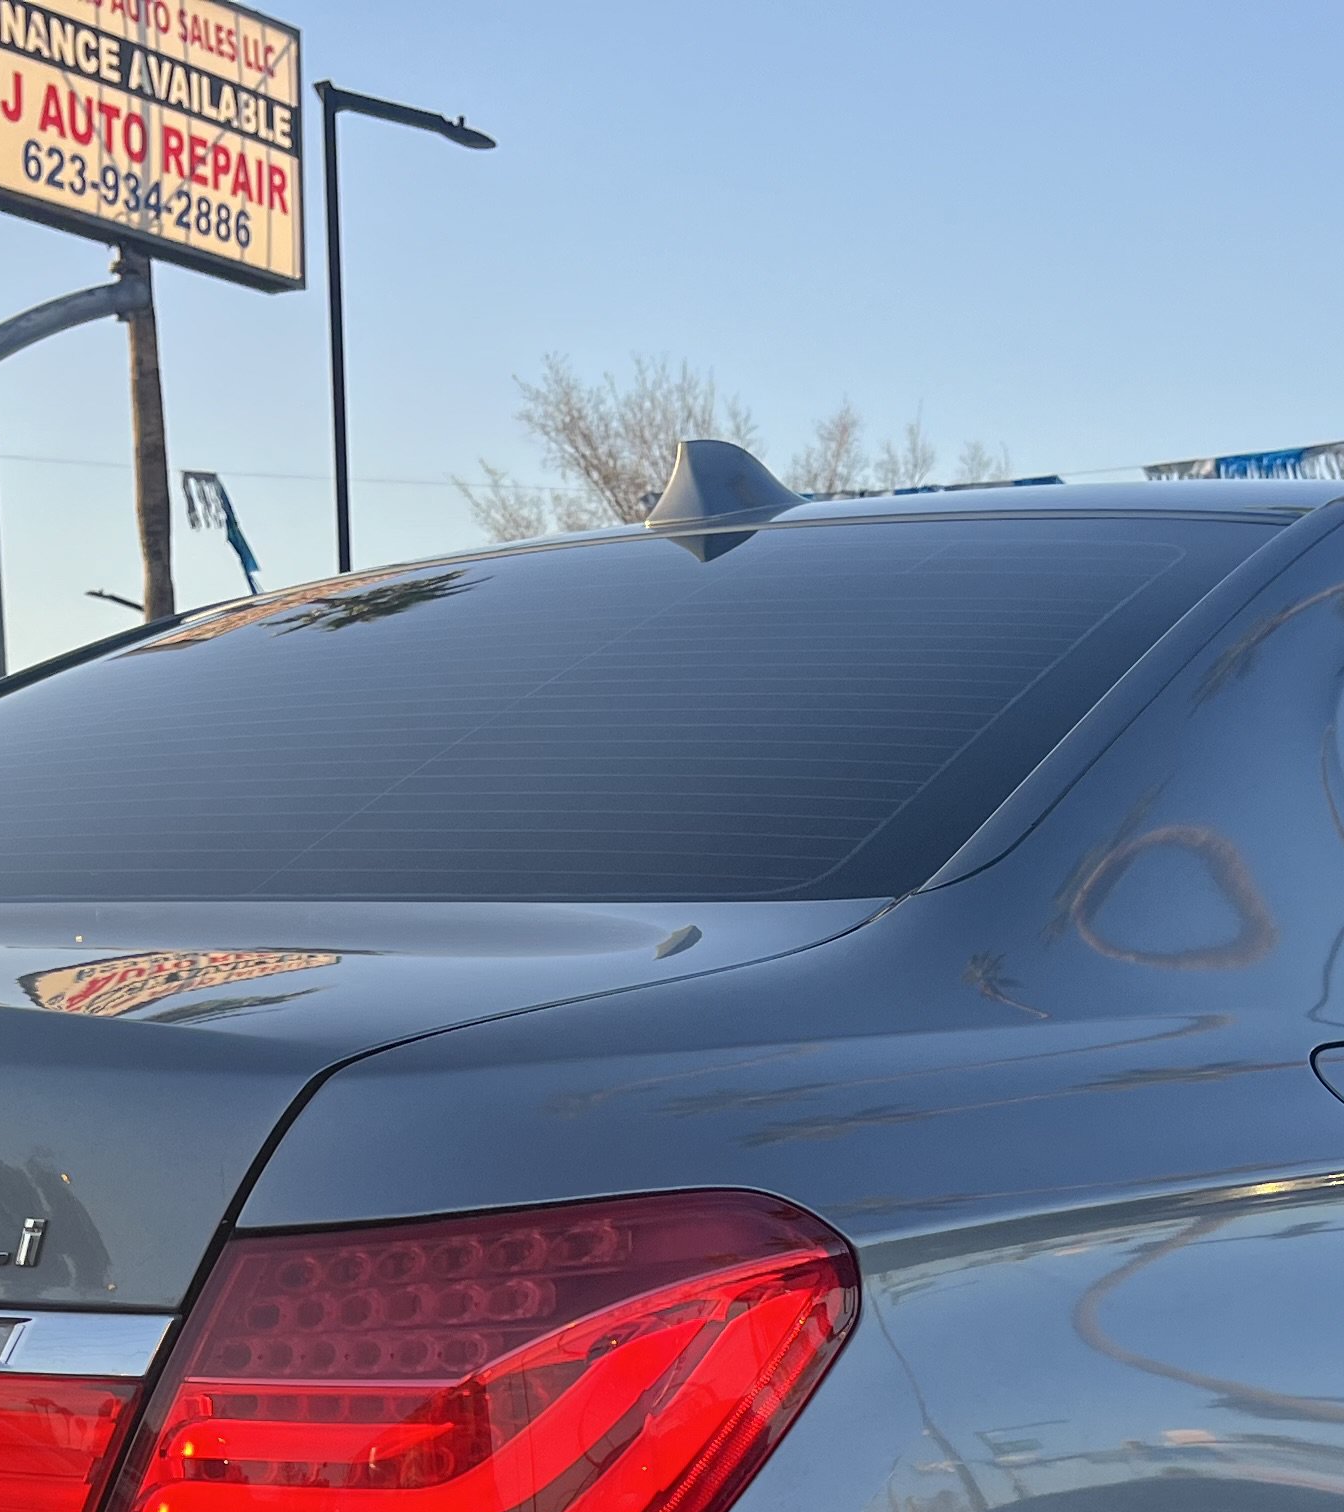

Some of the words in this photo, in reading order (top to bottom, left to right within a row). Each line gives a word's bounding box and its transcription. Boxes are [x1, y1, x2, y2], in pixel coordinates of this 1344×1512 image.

[178, 8, 237, 63] SALES
[243, 36, 276, 78] LLC
[40, 84, 148, 164] AUTO
[162, 125, 289, 215] REPAIR
[129, 48, 293, 149] AVAILABLE
[22, 139, 252, 249] 623-934-2886
